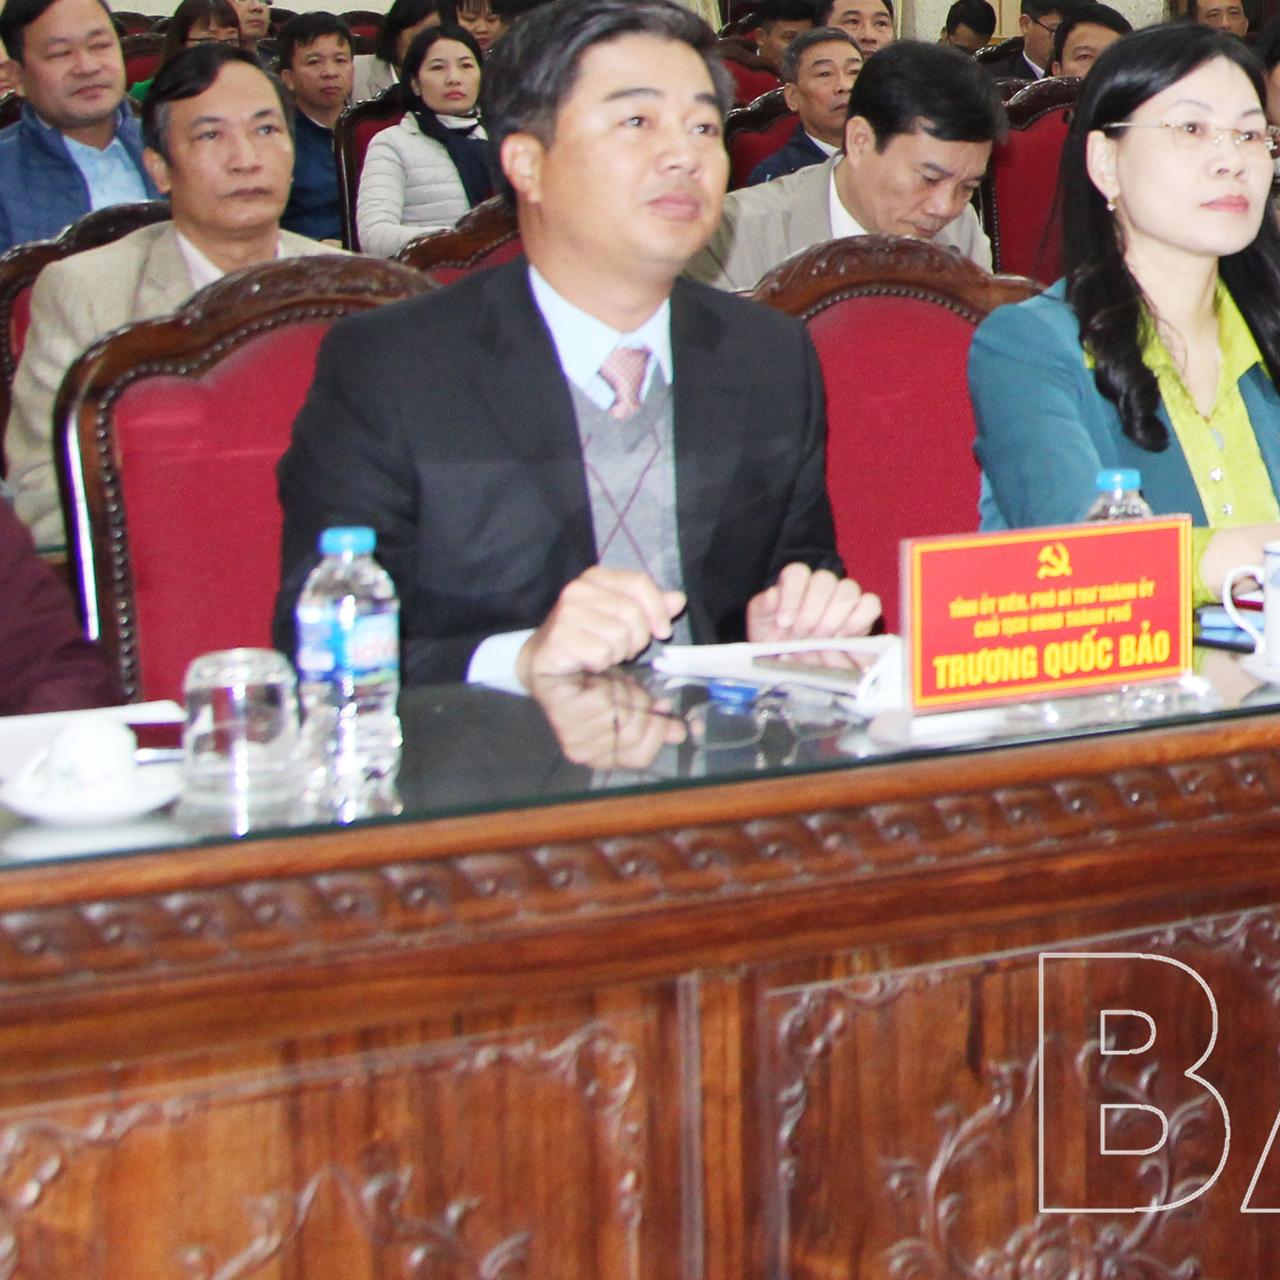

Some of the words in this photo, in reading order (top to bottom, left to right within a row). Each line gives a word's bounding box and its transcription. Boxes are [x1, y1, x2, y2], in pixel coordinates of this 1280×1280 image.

[933, 647, 1038, 690] TRƯƠNG
[1043, 627, 1113, 679] QUỐC
[1119, 619, 1171, 668] BẢO
